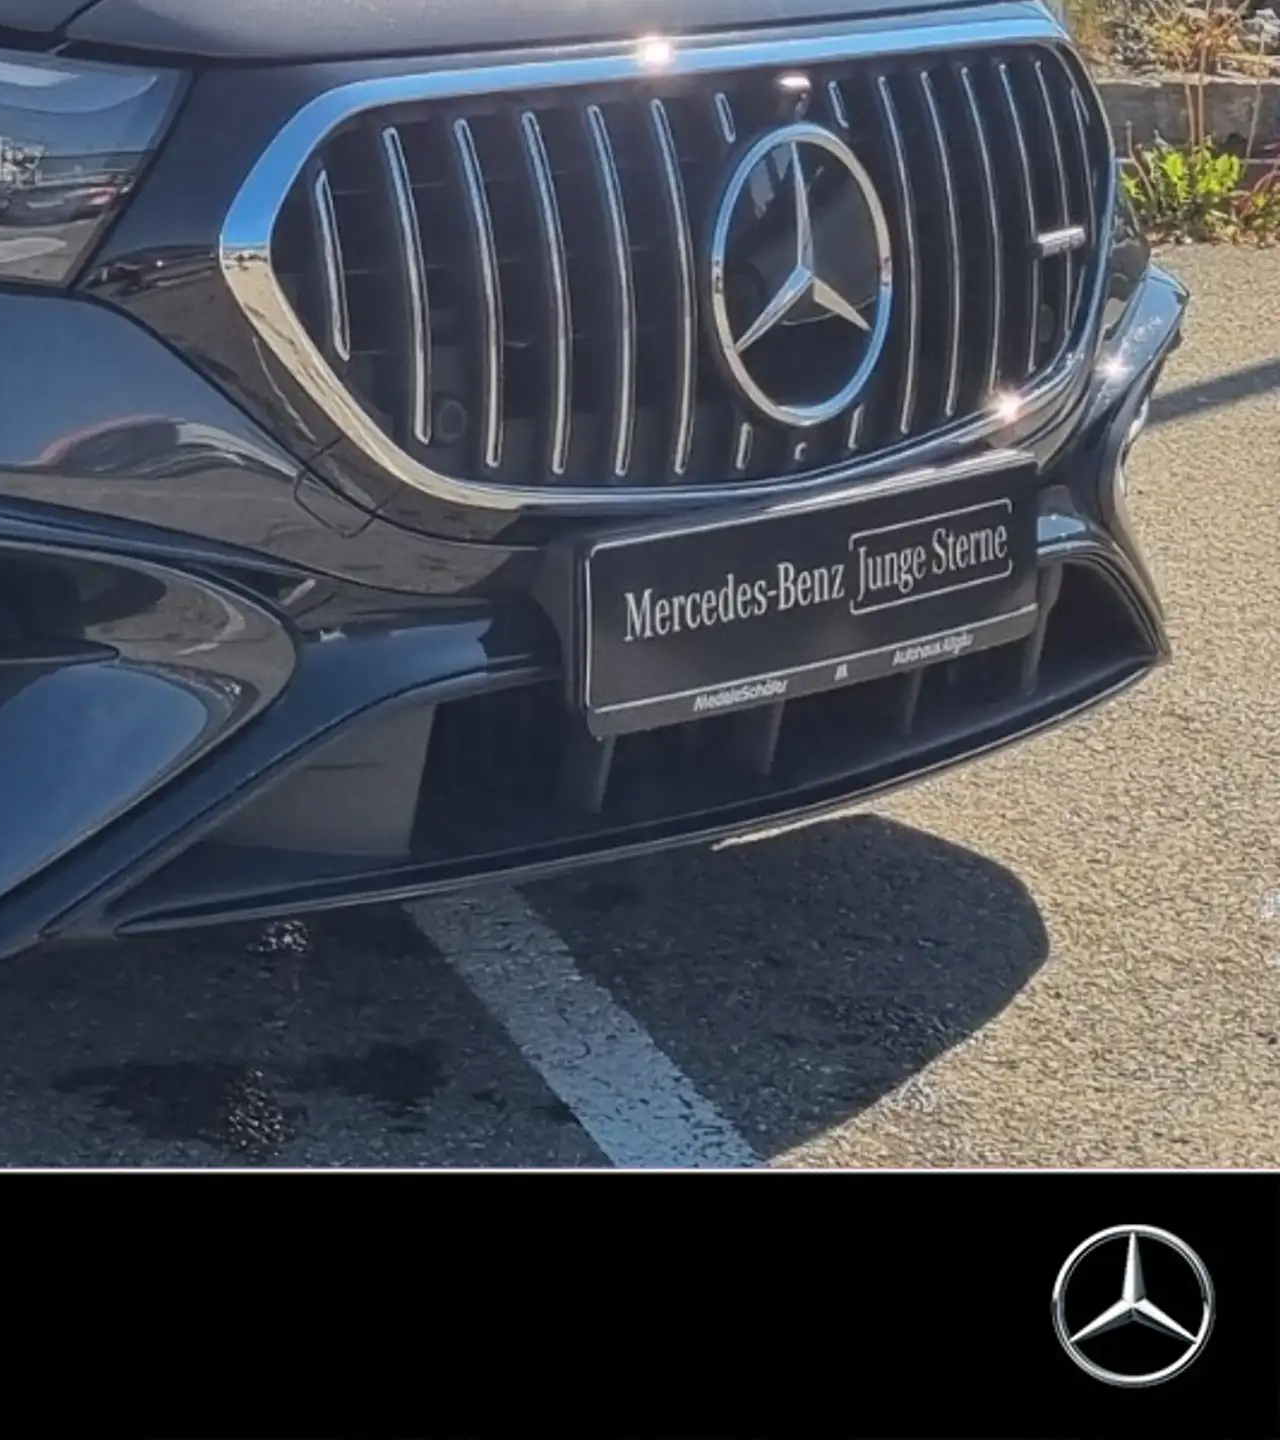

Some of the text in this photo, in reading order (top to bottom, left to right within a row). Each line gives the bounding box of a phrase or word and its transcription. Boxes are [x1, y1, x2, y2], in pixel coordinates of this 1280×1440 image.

[623, 523, 1009, 642] Mercedes-Benz Junge Sterne
